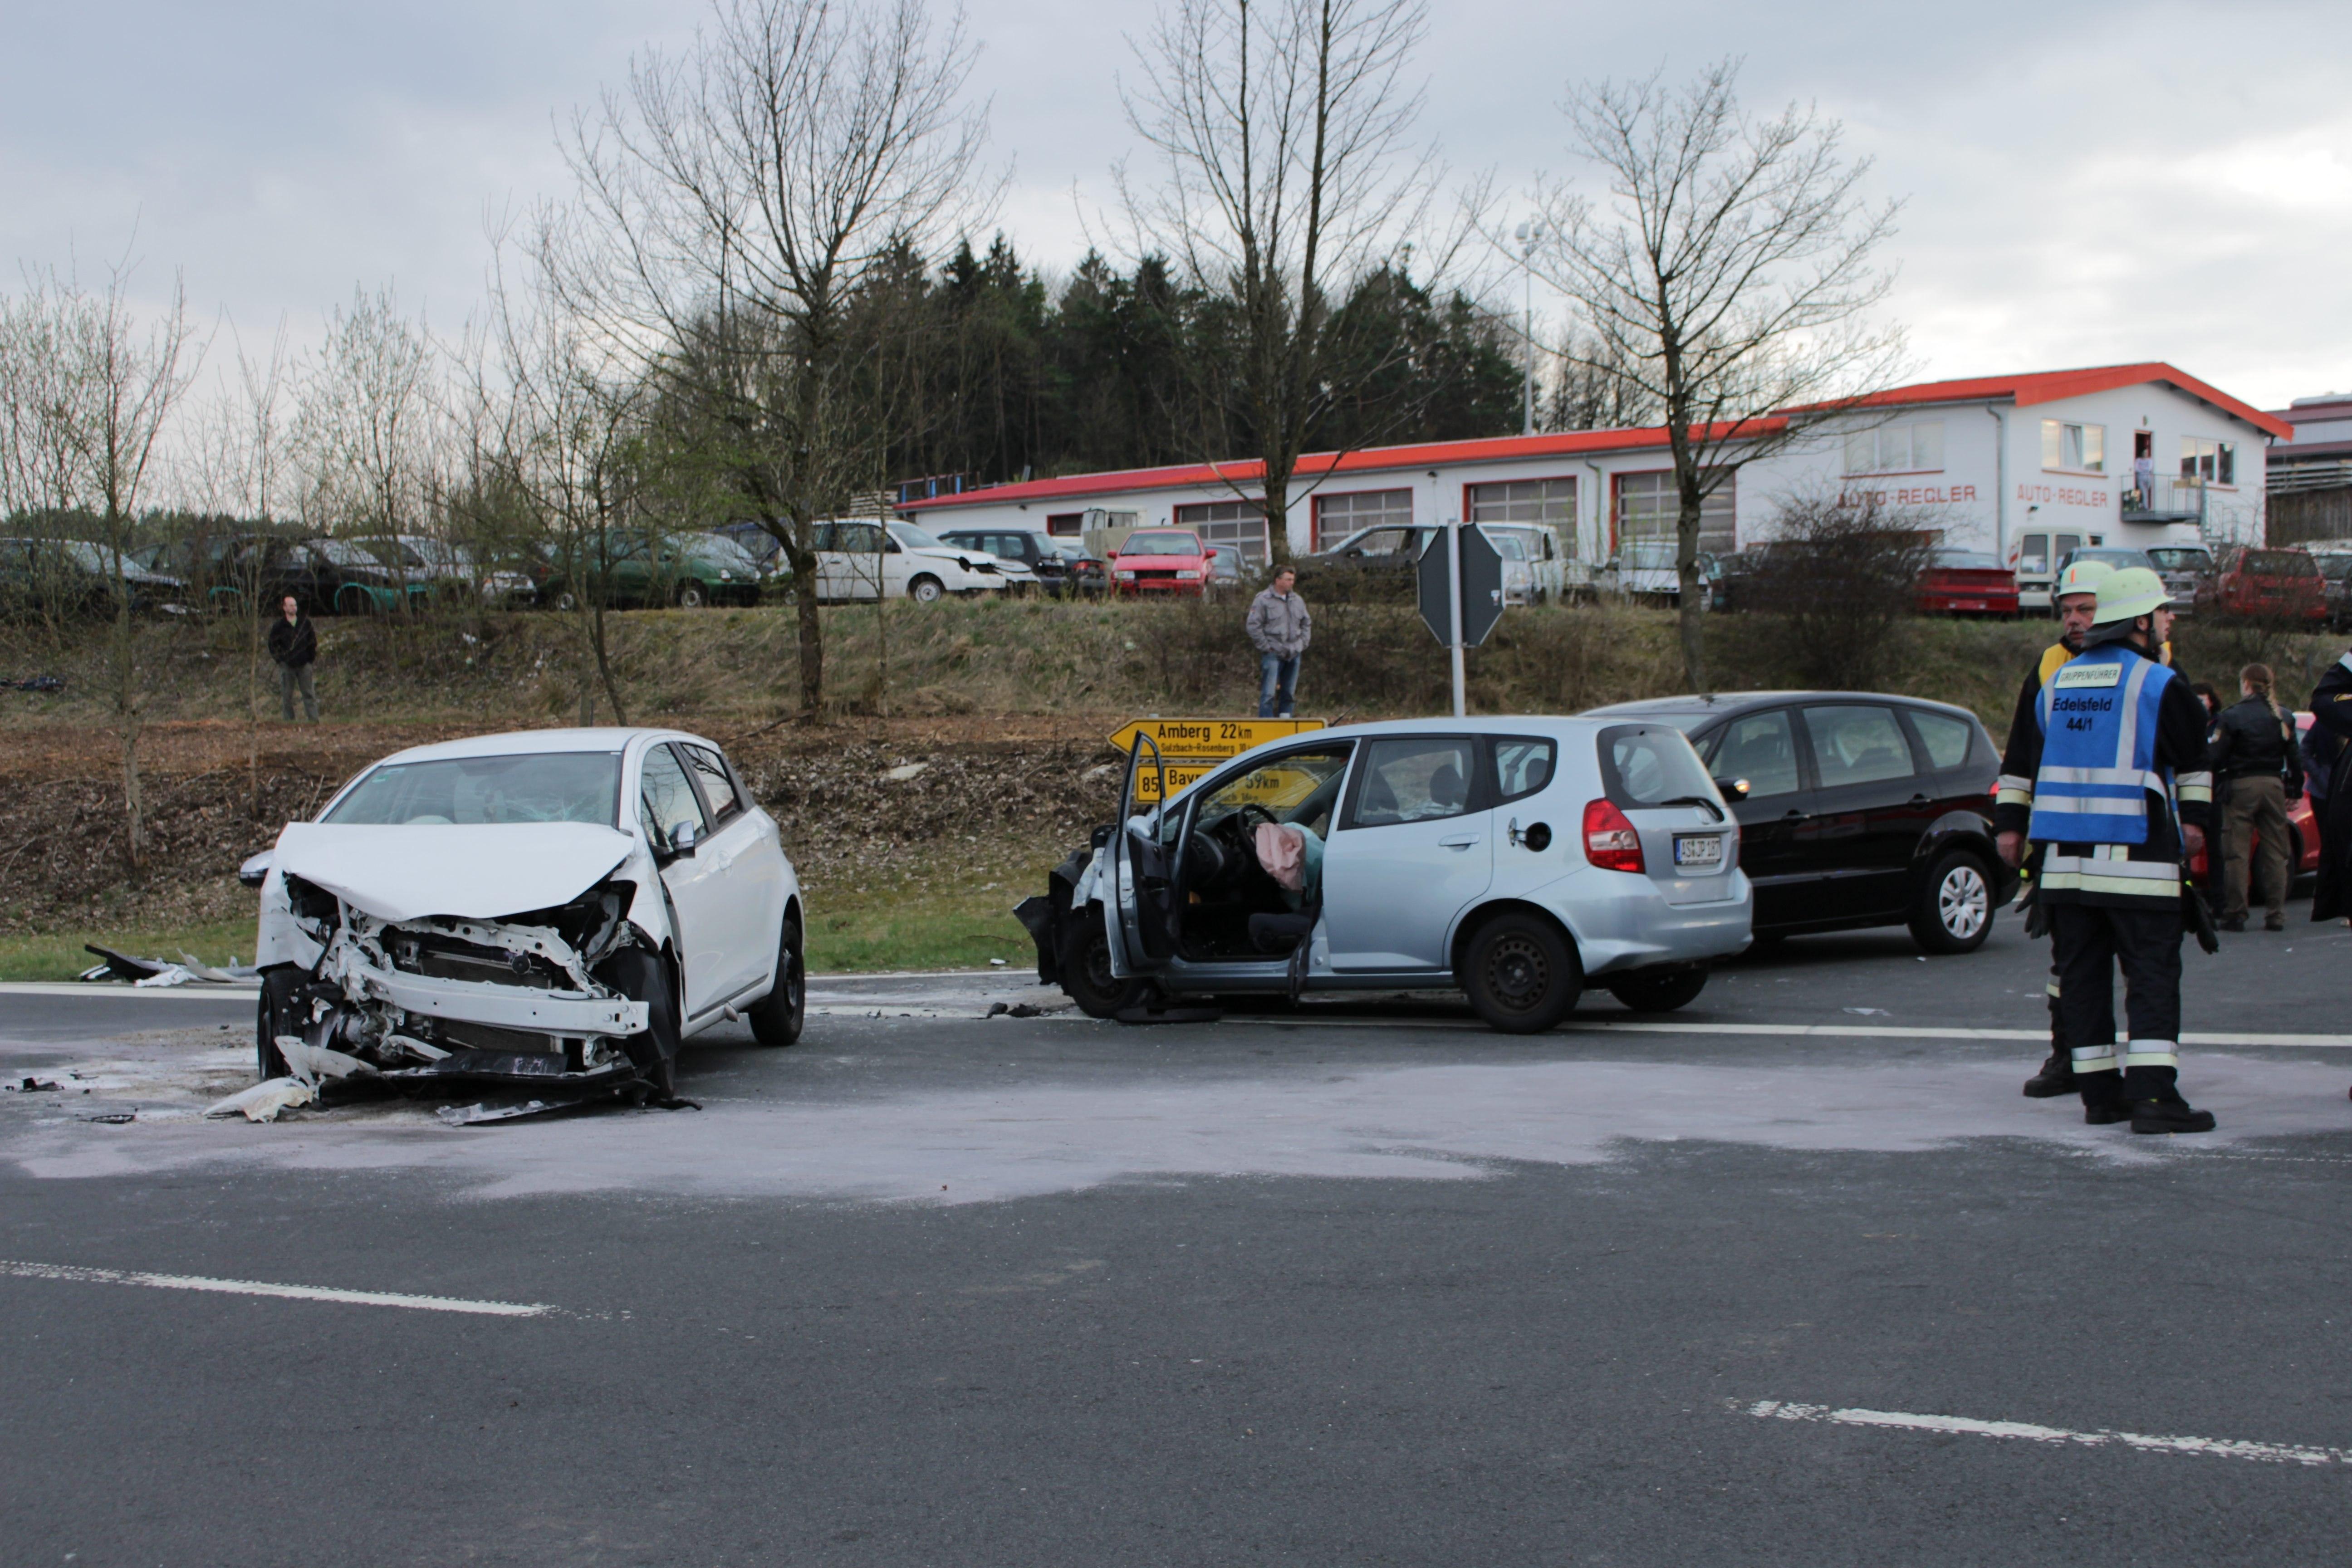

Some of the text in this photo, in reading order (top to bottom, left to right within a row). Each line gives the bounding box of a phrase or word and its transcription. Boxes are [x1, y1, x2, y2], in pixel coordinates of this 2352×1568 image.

[2060, 669, 2118, 682] GRUPPENFÜHRER
[2053, 697, 2112, 711] Edelsfeld
[2066, 717, 2092, 731] 44/1
[1158, 724, 1210, 742] Amberg
[1161, 744, 1235, 754] Sulzbach-Rosenberg
[1142, 777, 1159, 792] 85
